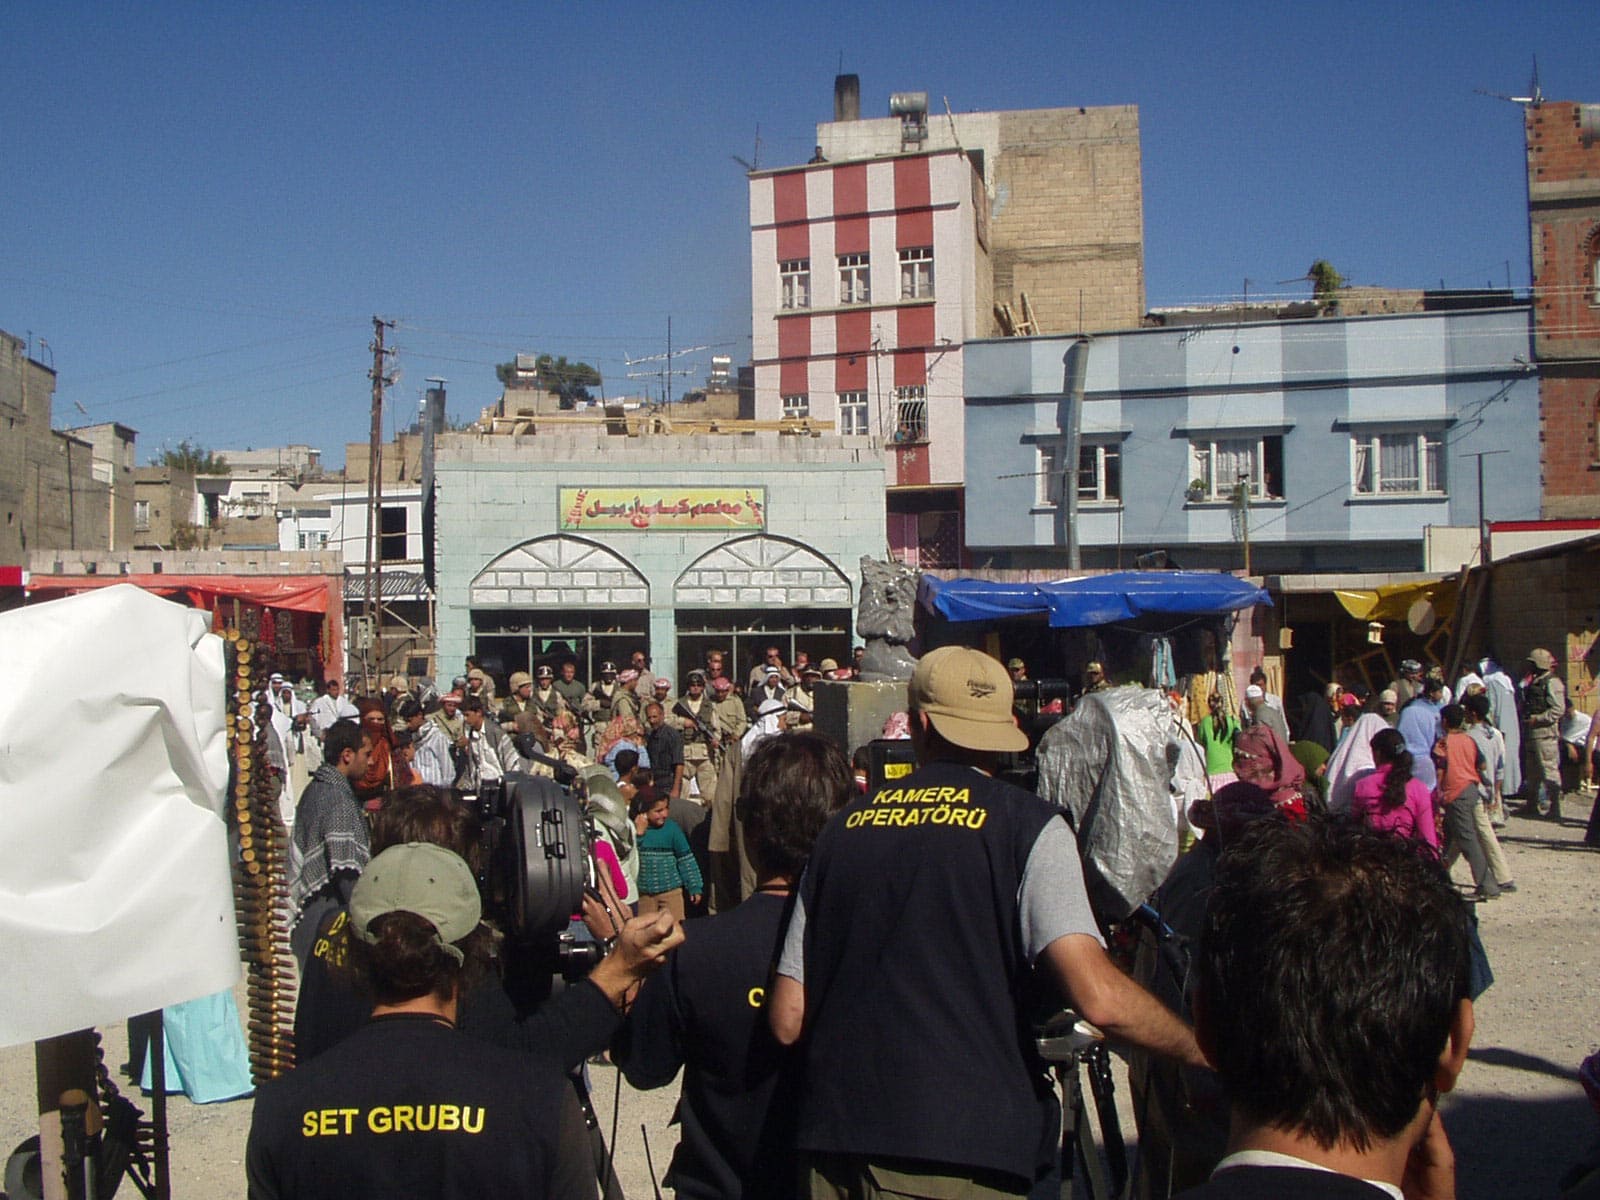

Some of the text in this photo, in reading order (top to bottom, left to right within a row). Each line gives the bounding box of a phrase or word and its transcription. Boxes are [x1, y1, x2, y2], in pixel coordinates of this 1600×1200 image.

[640, 498, 689, 518] كباب
[690, 499, 742, 519] مطعم
[872, 786, 970, 805] KAMERA
[845, 804, 987, 829] OPERATÖRÜ
[302, 1104, 486, 1137] SET GRUBU
